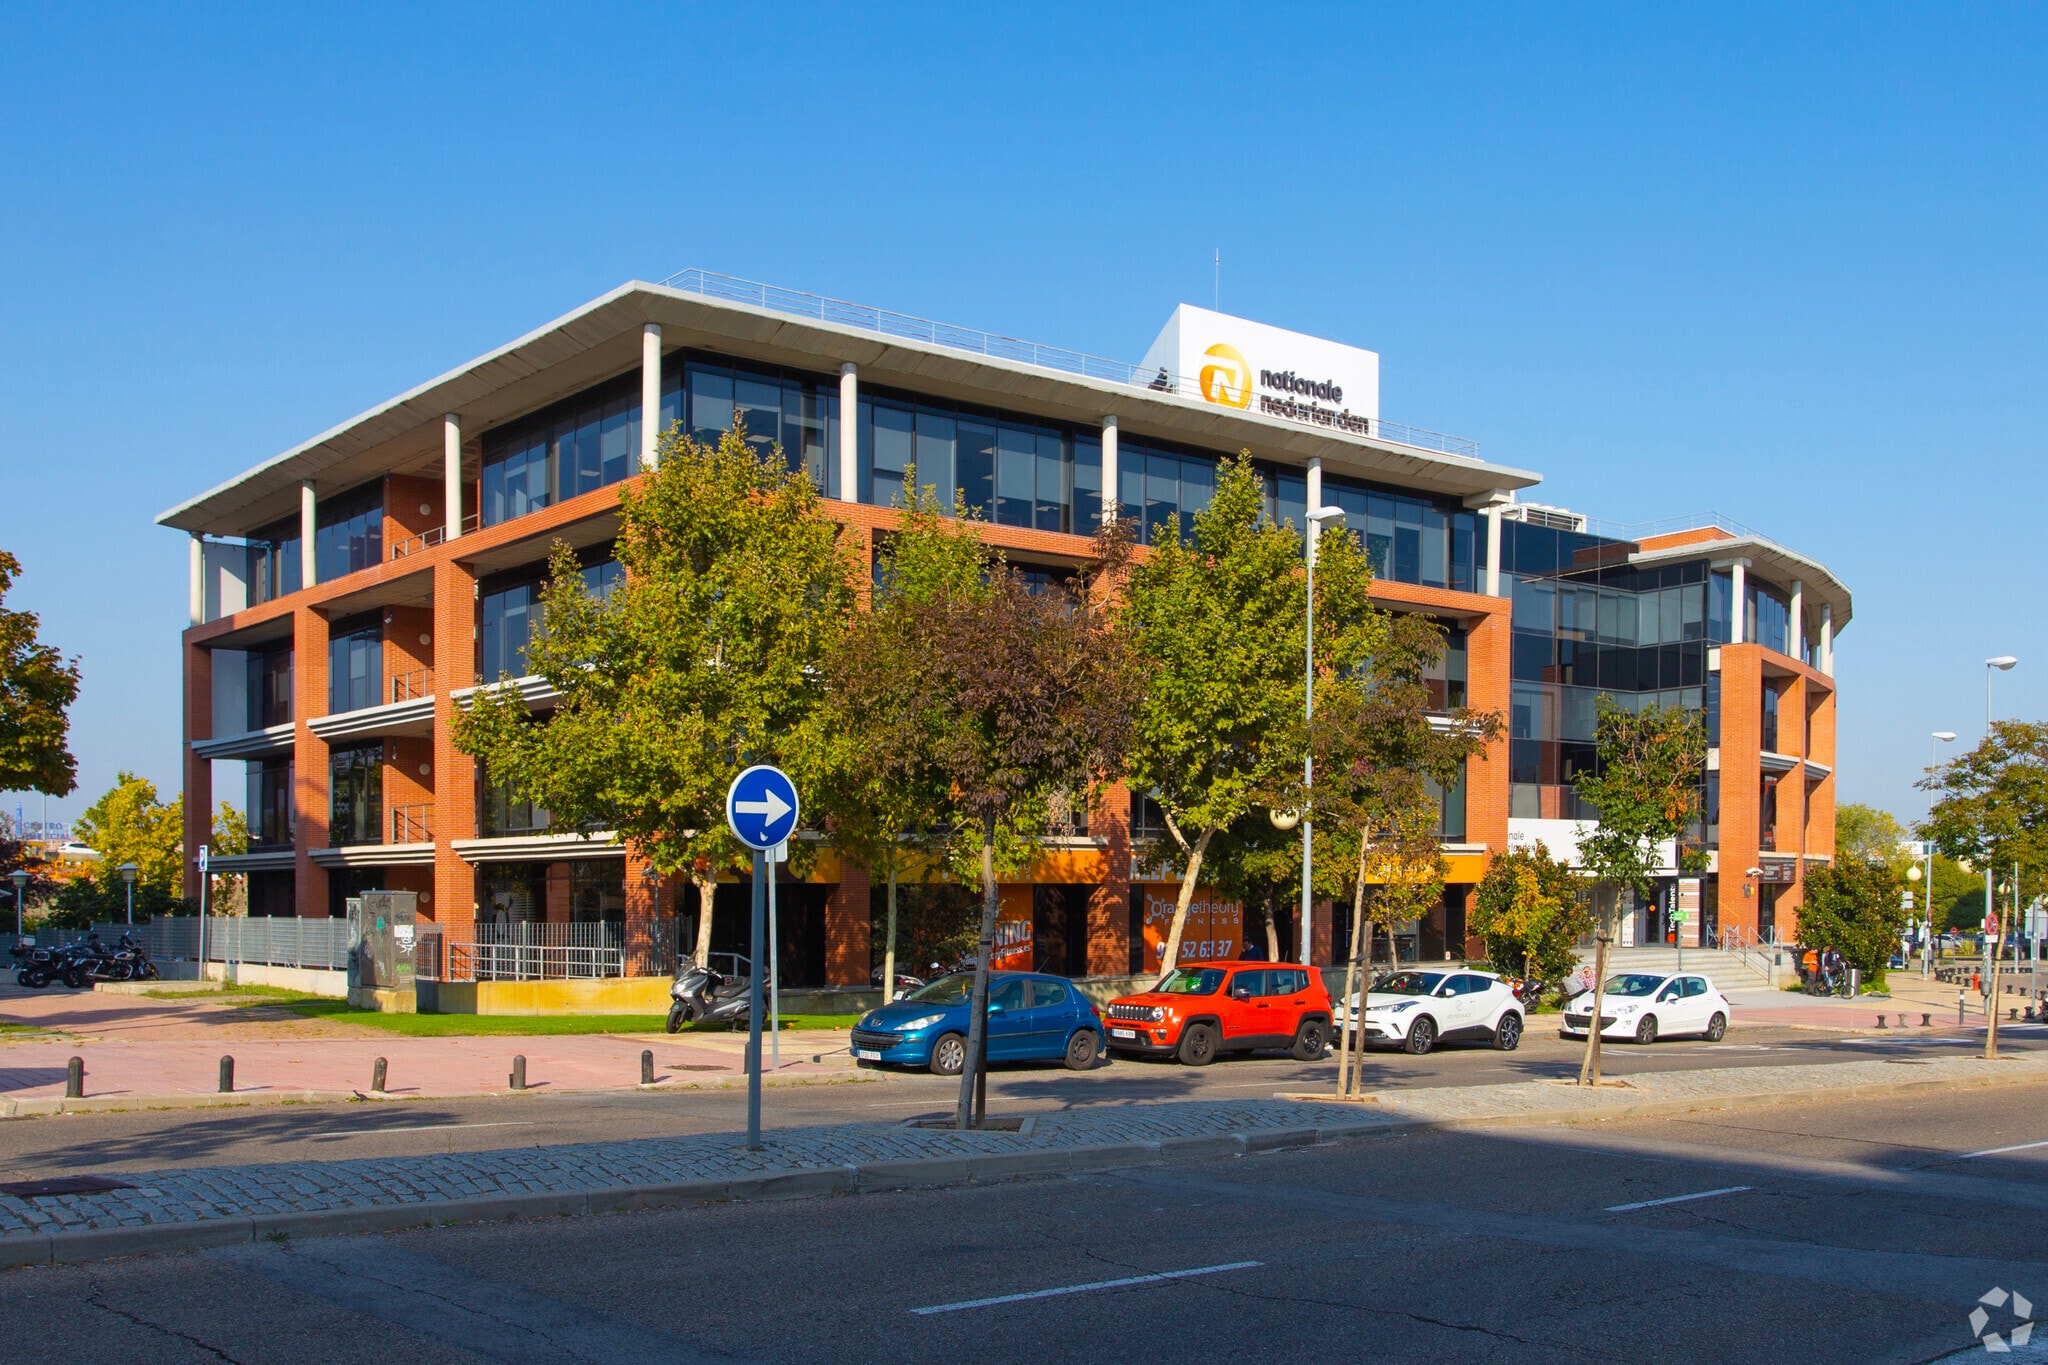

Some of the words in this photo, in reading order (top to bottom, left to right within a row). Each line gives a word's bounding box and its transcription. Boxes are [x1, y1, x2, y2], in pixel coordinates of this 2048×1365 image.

[1261, 369, 1343, 403] nationale
[1261, 395, 1369, 434] nederlanden
[1147, 895, 1239, 922] Oragetheory
[1181, 941, 1197, 958] 52
[1199, 940, 1215, 957] 63
[1217, 940, 1232, 957] 37
